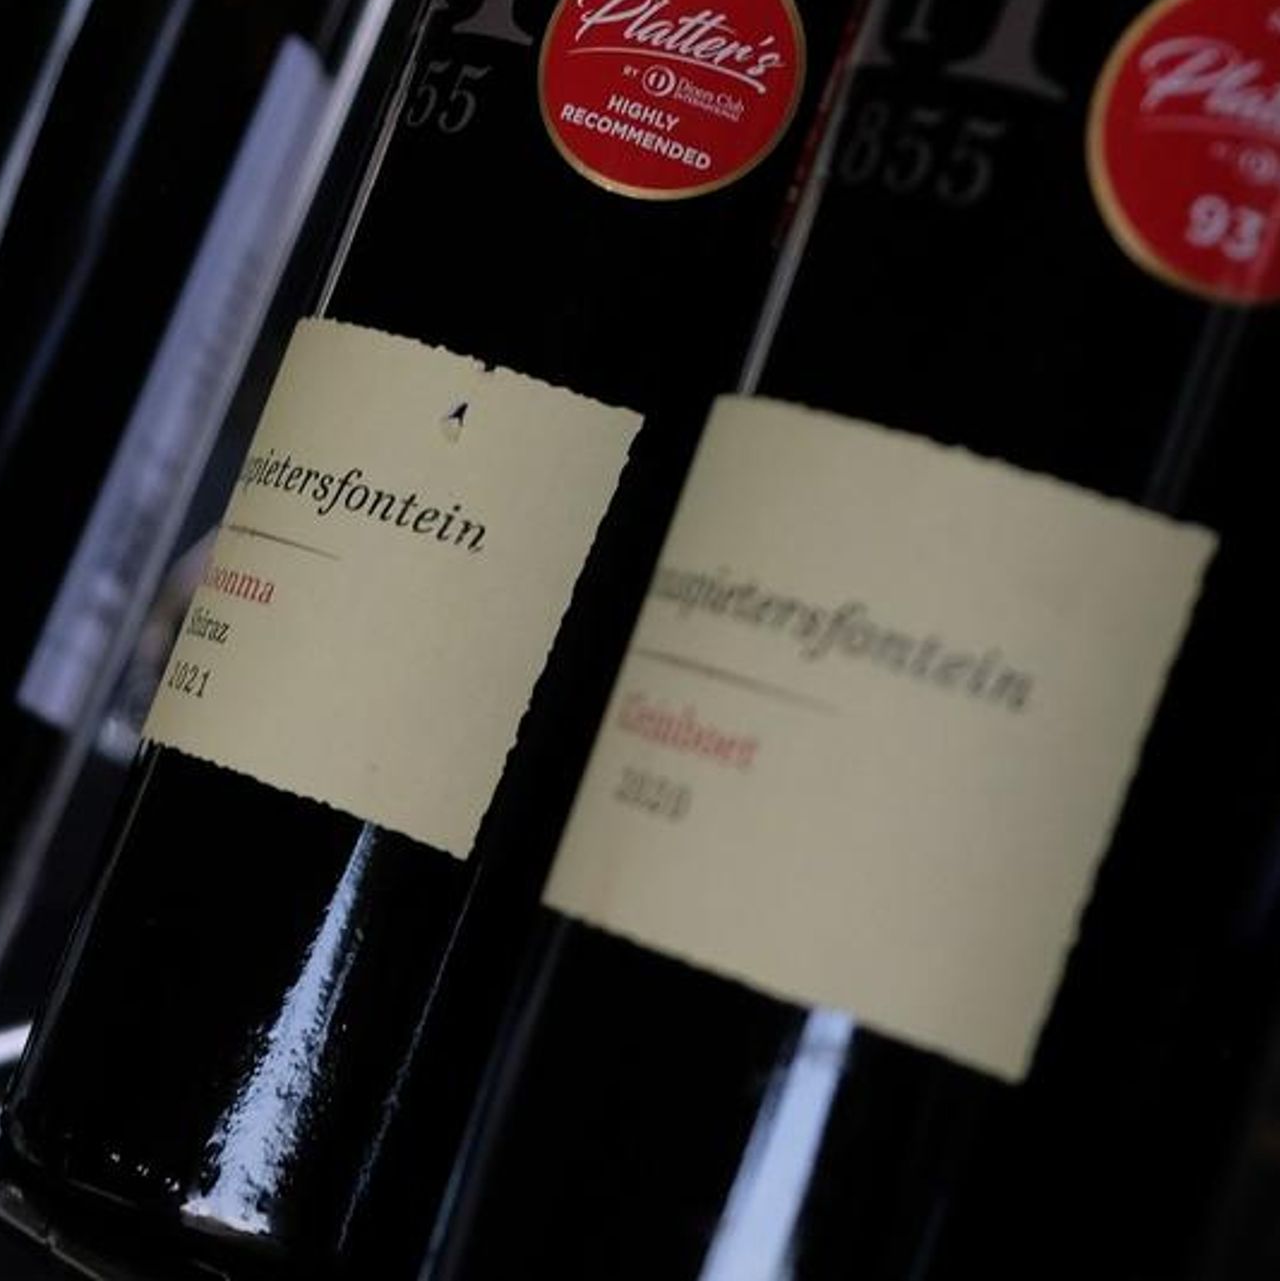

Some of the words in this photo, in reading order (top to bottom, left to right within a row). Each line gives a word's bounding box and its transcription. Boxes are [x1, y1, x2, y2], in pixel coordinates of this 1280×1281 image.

[559, 103, 713, 172] RECOMMENDED
[606, 94, 681, 133] HIGHLY
[1181, 192, 1267, 263] 93
